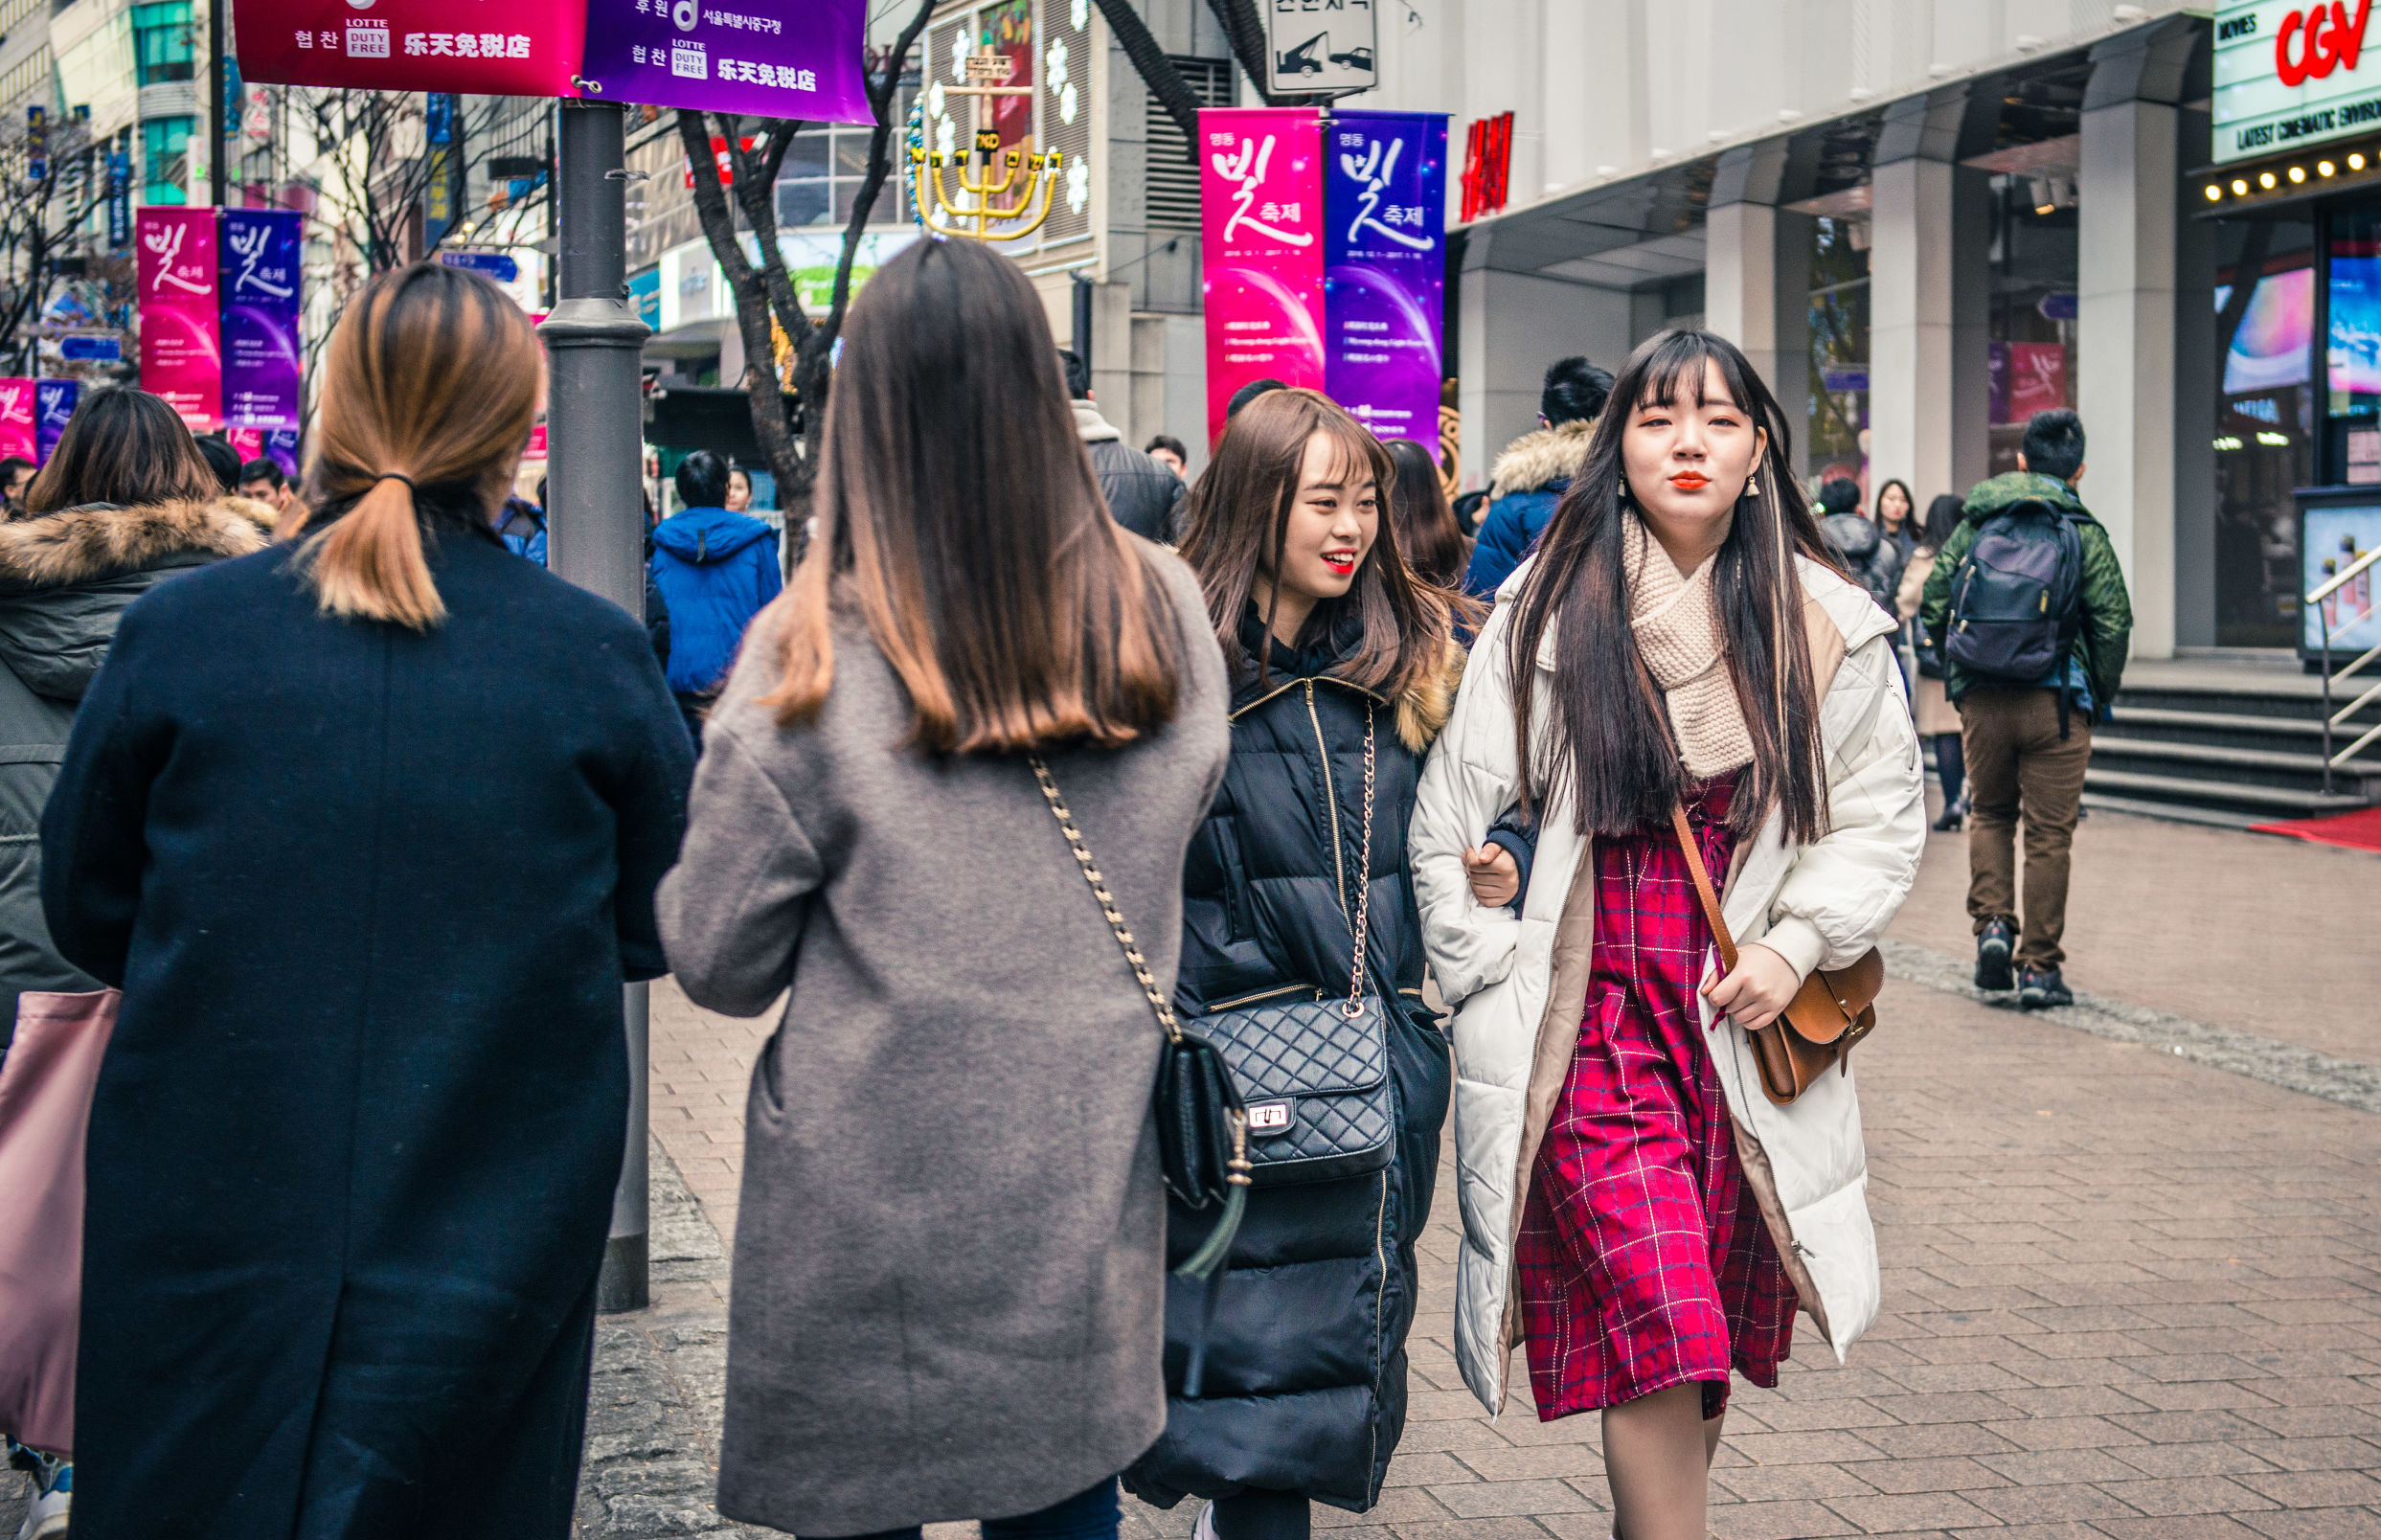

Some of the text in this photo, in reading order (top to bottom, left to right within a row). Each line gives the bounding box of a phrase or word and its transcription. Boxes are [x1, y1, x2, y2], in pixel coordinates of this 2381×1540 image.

[346, 18, 388, 28] LOTTE
[703, 9, 782, 34] 서울특별시중구청
[351, 33, 385, 42] DUTY
[351, 44, 385, 54] FREE
[404, 33, 531, 57] 乐天免税店
[672, 38, 705, 51] LOTTE
[2276, 0, 2372, 87] CGV
[675, 53, 702, 64] DUTY
[676, 63, 703, 75] FREE
[717, 58, 816, 92] 乐天免税店
[2237, 124, 2275, 150] LATEST
[2279, 109, 2335, 141] CINEMATIC
[1212, 134, 1313, 246] 빛
[1340, 137, 1435, 251] 빛
[1259, 202, 1301, 223] 축제
[1383, 204, 1423, 227] 축제
